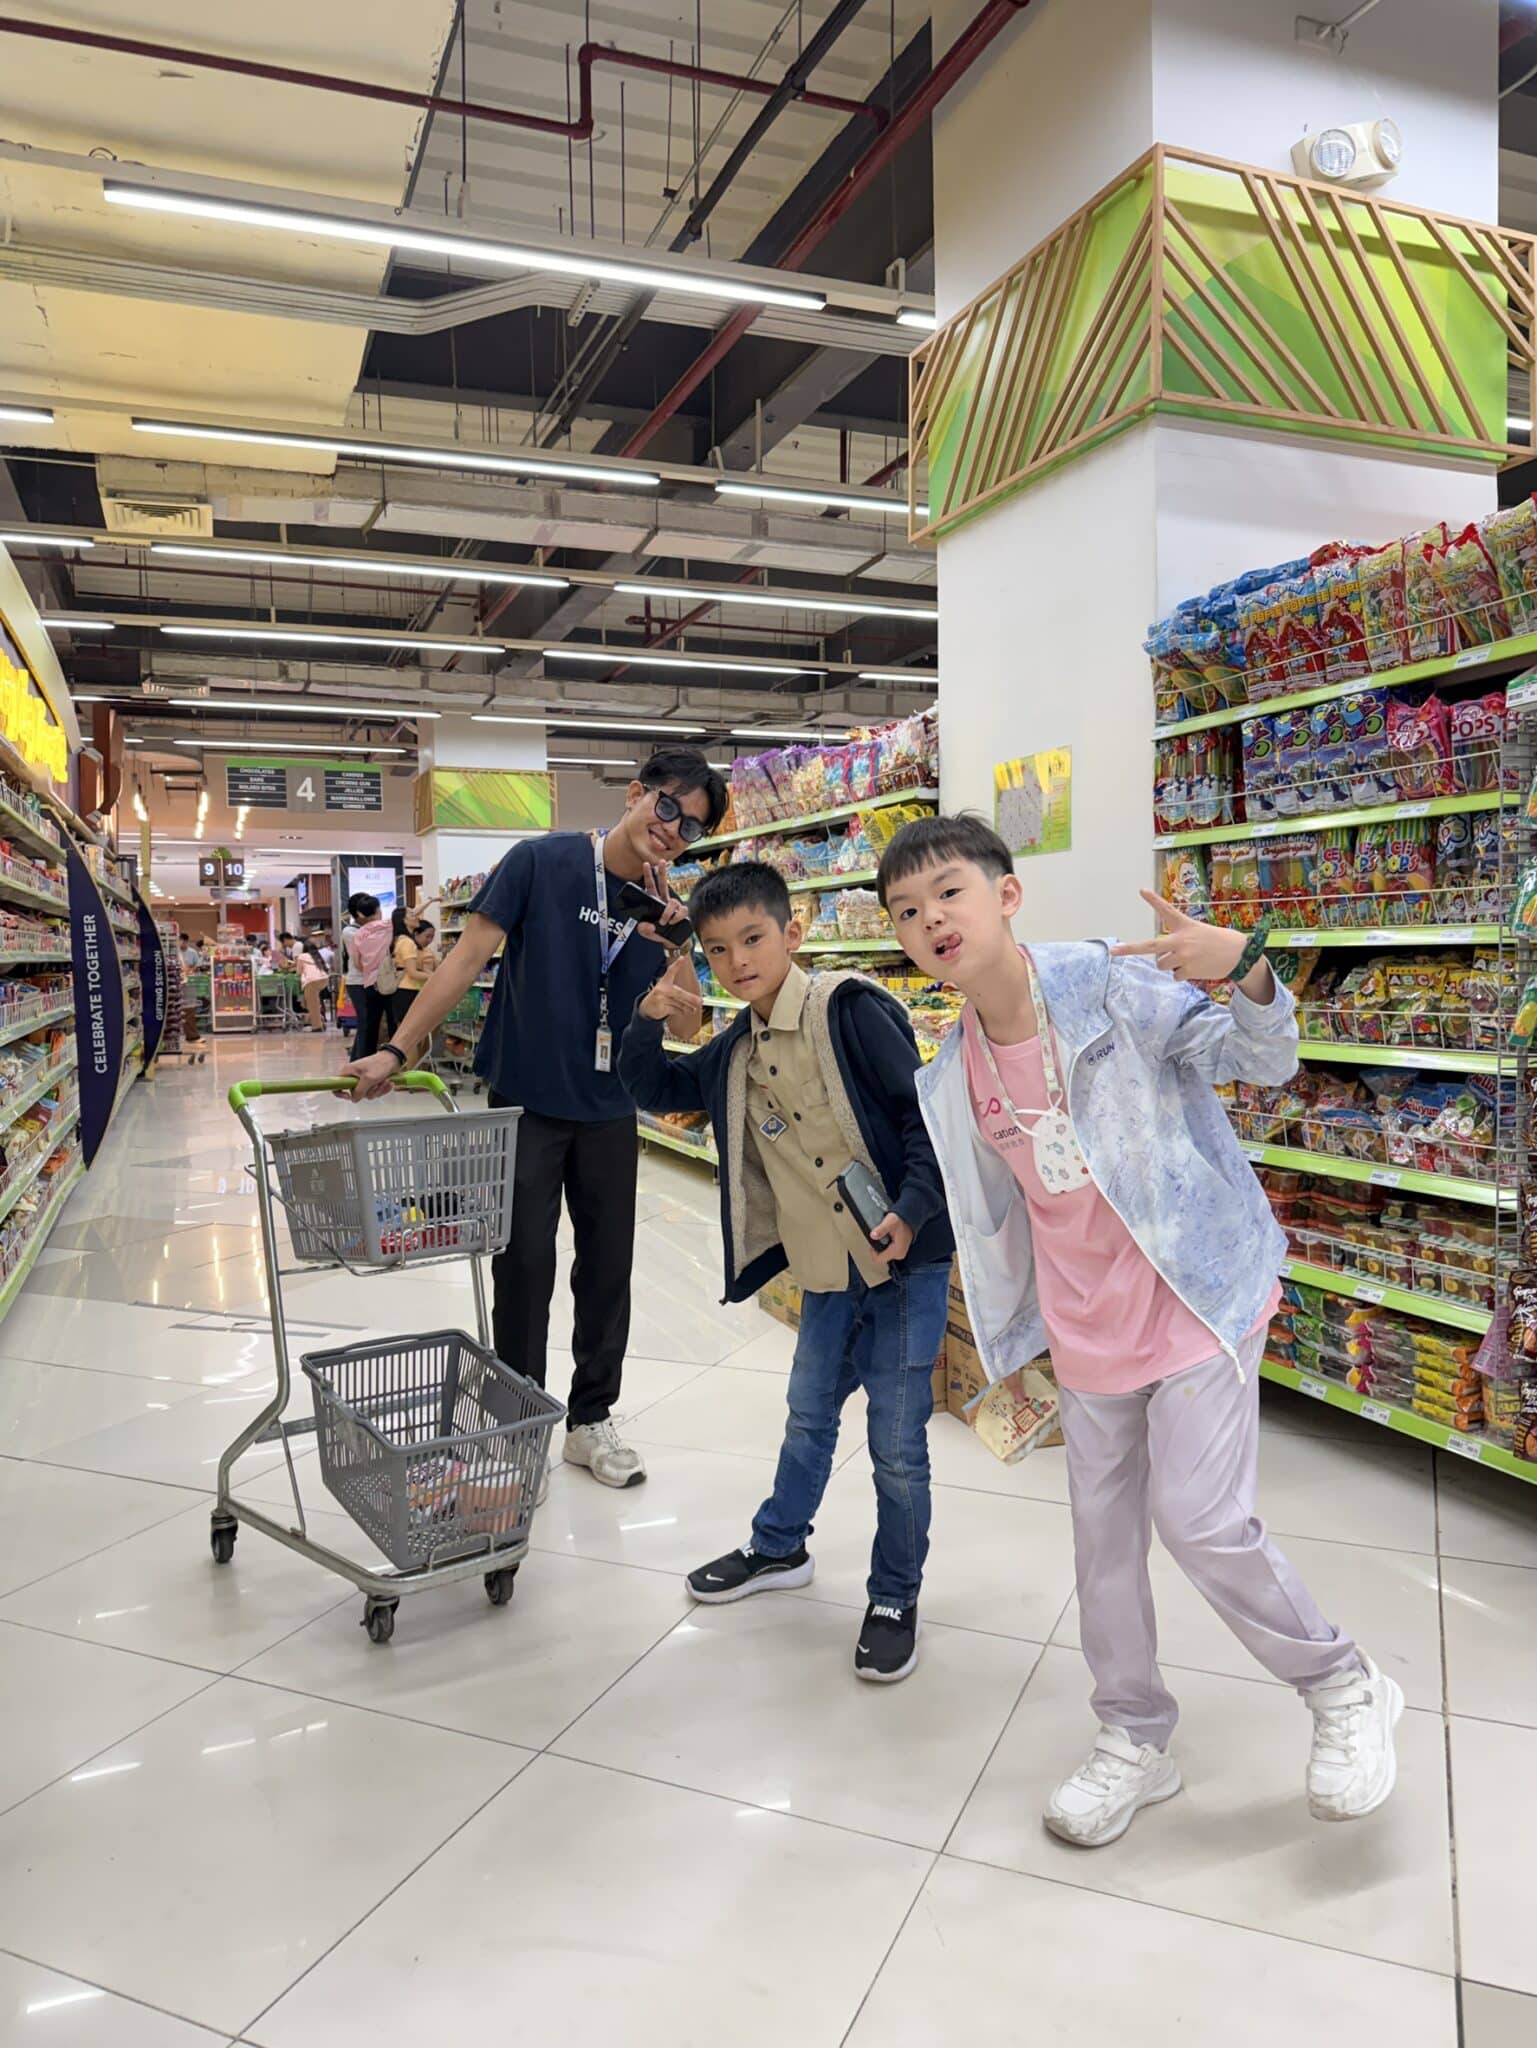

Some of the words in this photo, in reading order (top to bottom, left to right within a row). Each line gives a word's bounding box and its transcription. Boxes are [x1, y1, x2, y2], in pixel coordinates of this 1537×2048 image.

[296, 776, 316, 802] 4
[204, 863, 215, 876] 9
[225, 863, 243, 876] 10
[578, 905, 624, 936] HOES
[83, 914, 101, 992] TOGETHER
[154, 950, 163, 986] SECTION
[155, 988, 163, 1021] GIFTING
[90, 994, 108, 1074] CELEBRATE
[1096, 1041, 1115, 1060] RUN
[871, 1605, 902, 1621] NIKE
